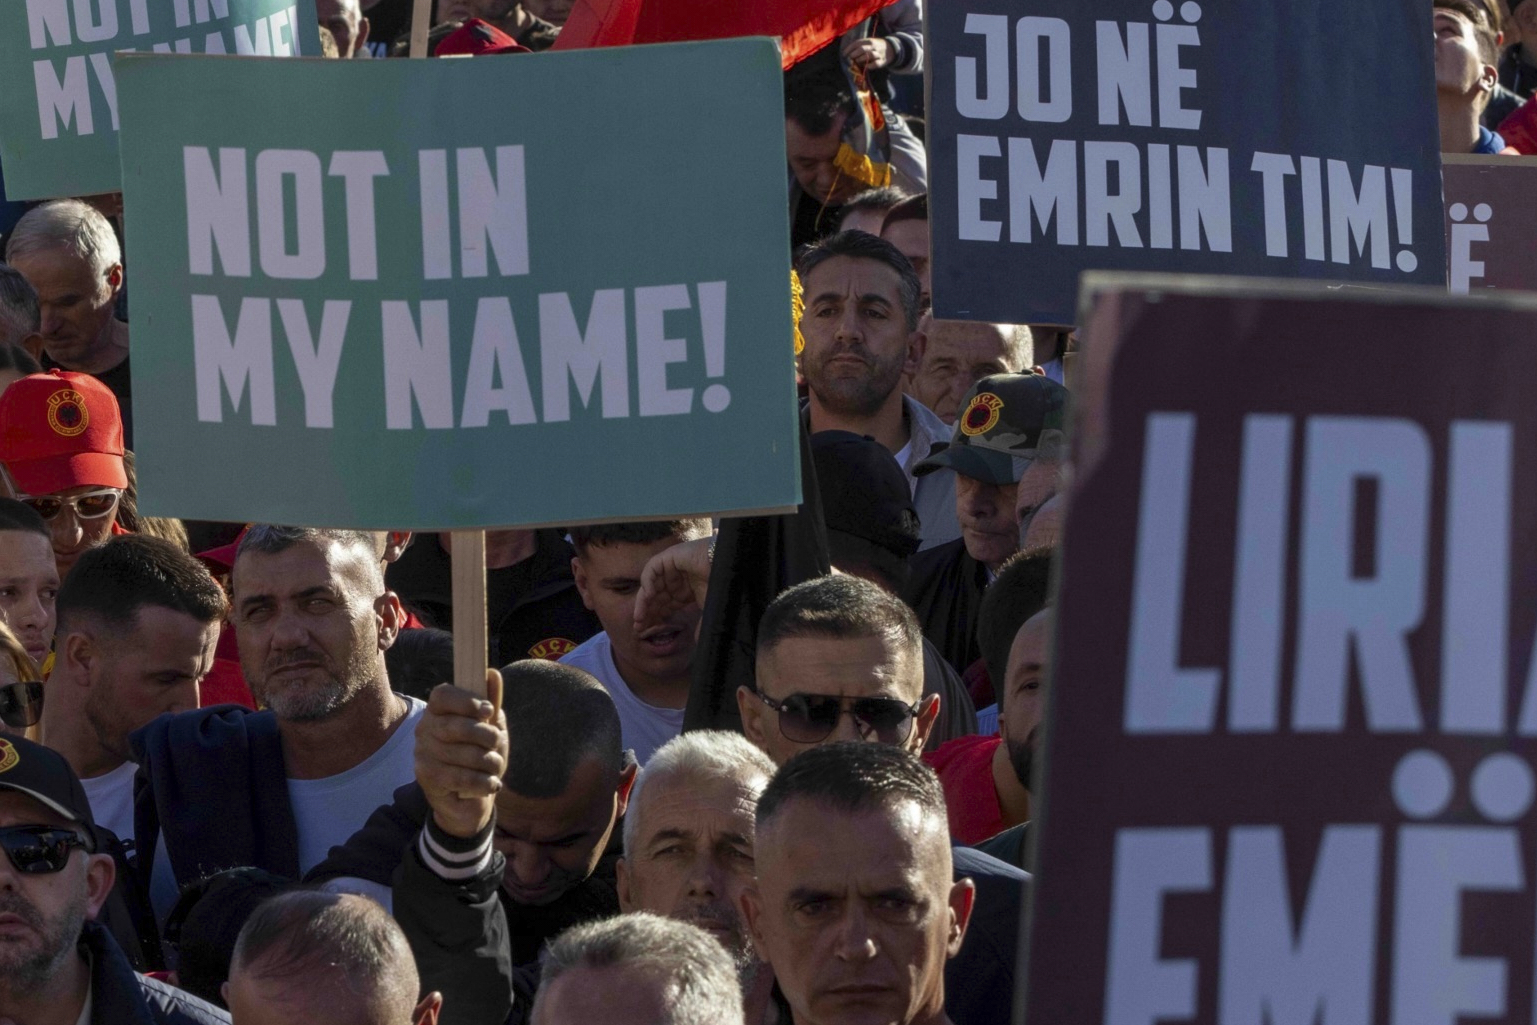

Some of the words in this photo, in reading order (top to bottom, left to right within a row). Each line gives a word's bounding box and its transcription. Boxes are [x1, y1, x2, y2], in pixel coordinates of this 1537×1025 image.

[954, 12, 1073, 123] JO
[183, 145, 392, 282] NOT
[417, 144, 530, 280] IN
[956, 132, 1233, 254] EMRIN
[1250, 150, 1419, 274] TIM!
[190, 294, 353, 429] MY
[381, 279, 733, 431] NAME!
[1123, 411, 1537, 739] LIRI
